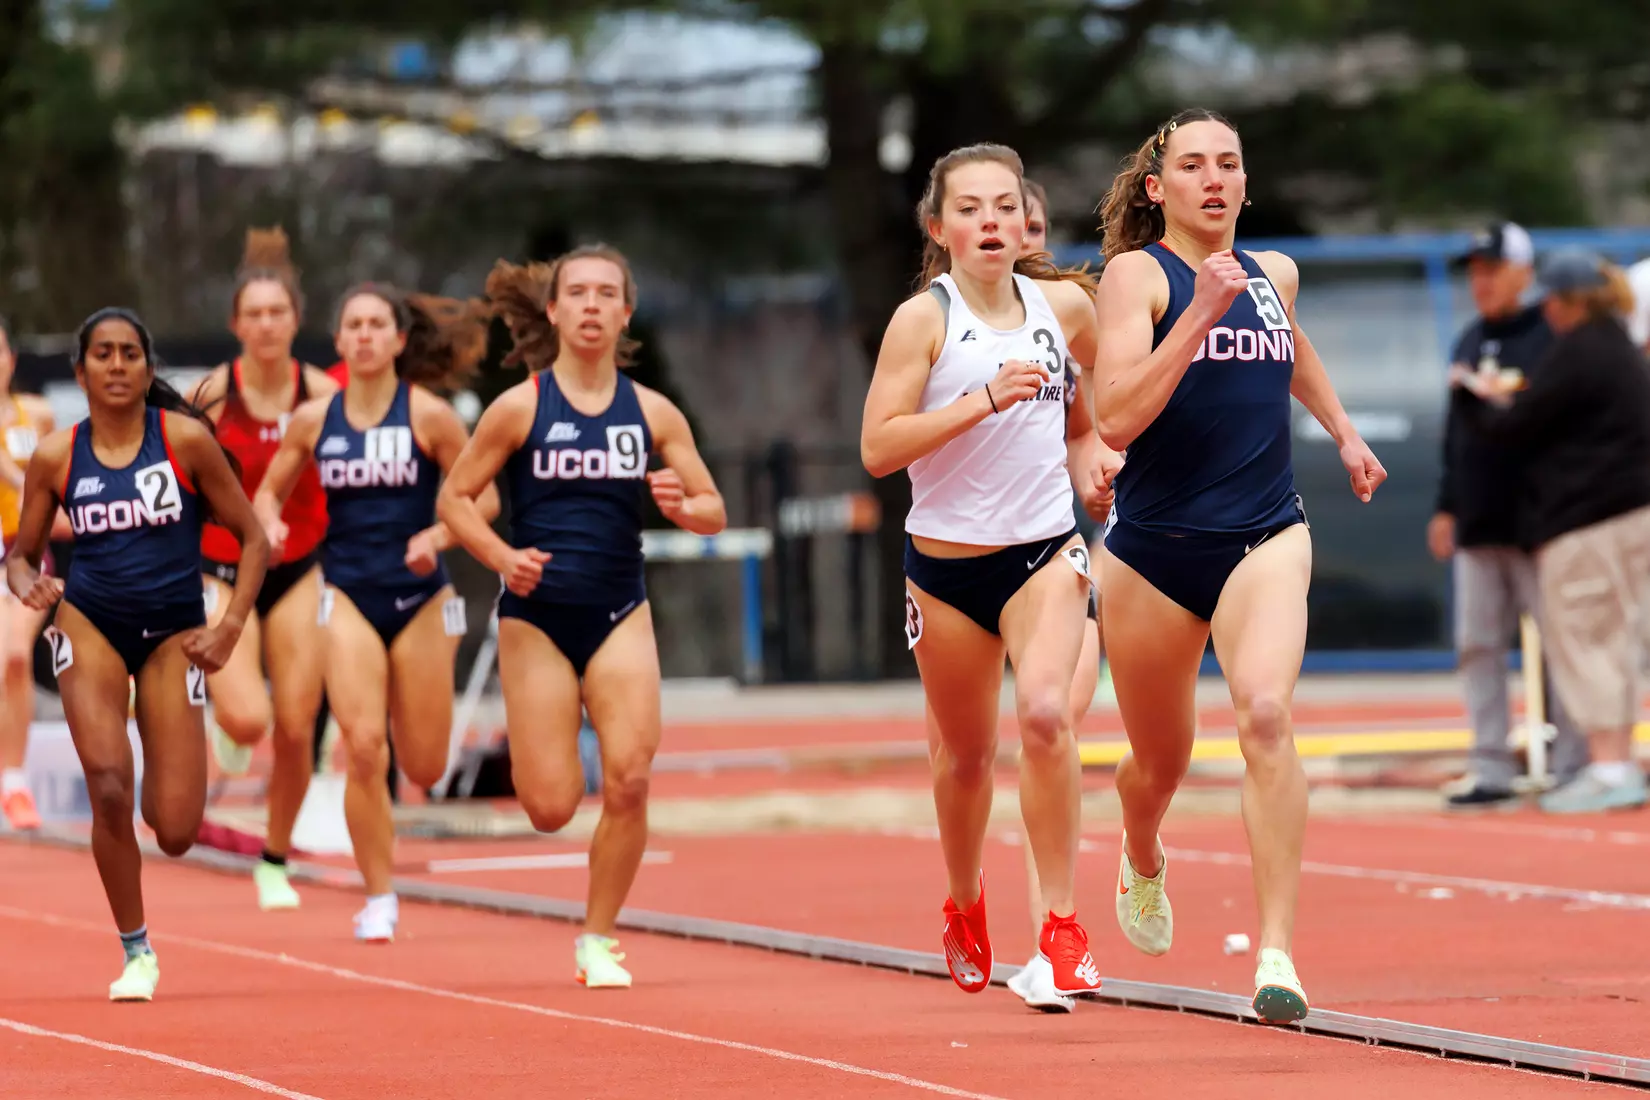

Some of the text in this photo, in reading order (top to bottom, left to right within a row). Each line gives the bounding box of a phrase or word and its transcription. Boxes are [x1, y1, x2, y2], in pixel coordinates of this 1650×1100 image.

[1250, 281, 1284, 326] 5
[1032, 328, 1062, 374] 3
[532, 447, 649, 480] UCO
[616, 431, 640, 471] 9
[143, 470, 176, 512] 2
[907, 595, 920, 639] 3
[50, 631, 68, 670] 2
